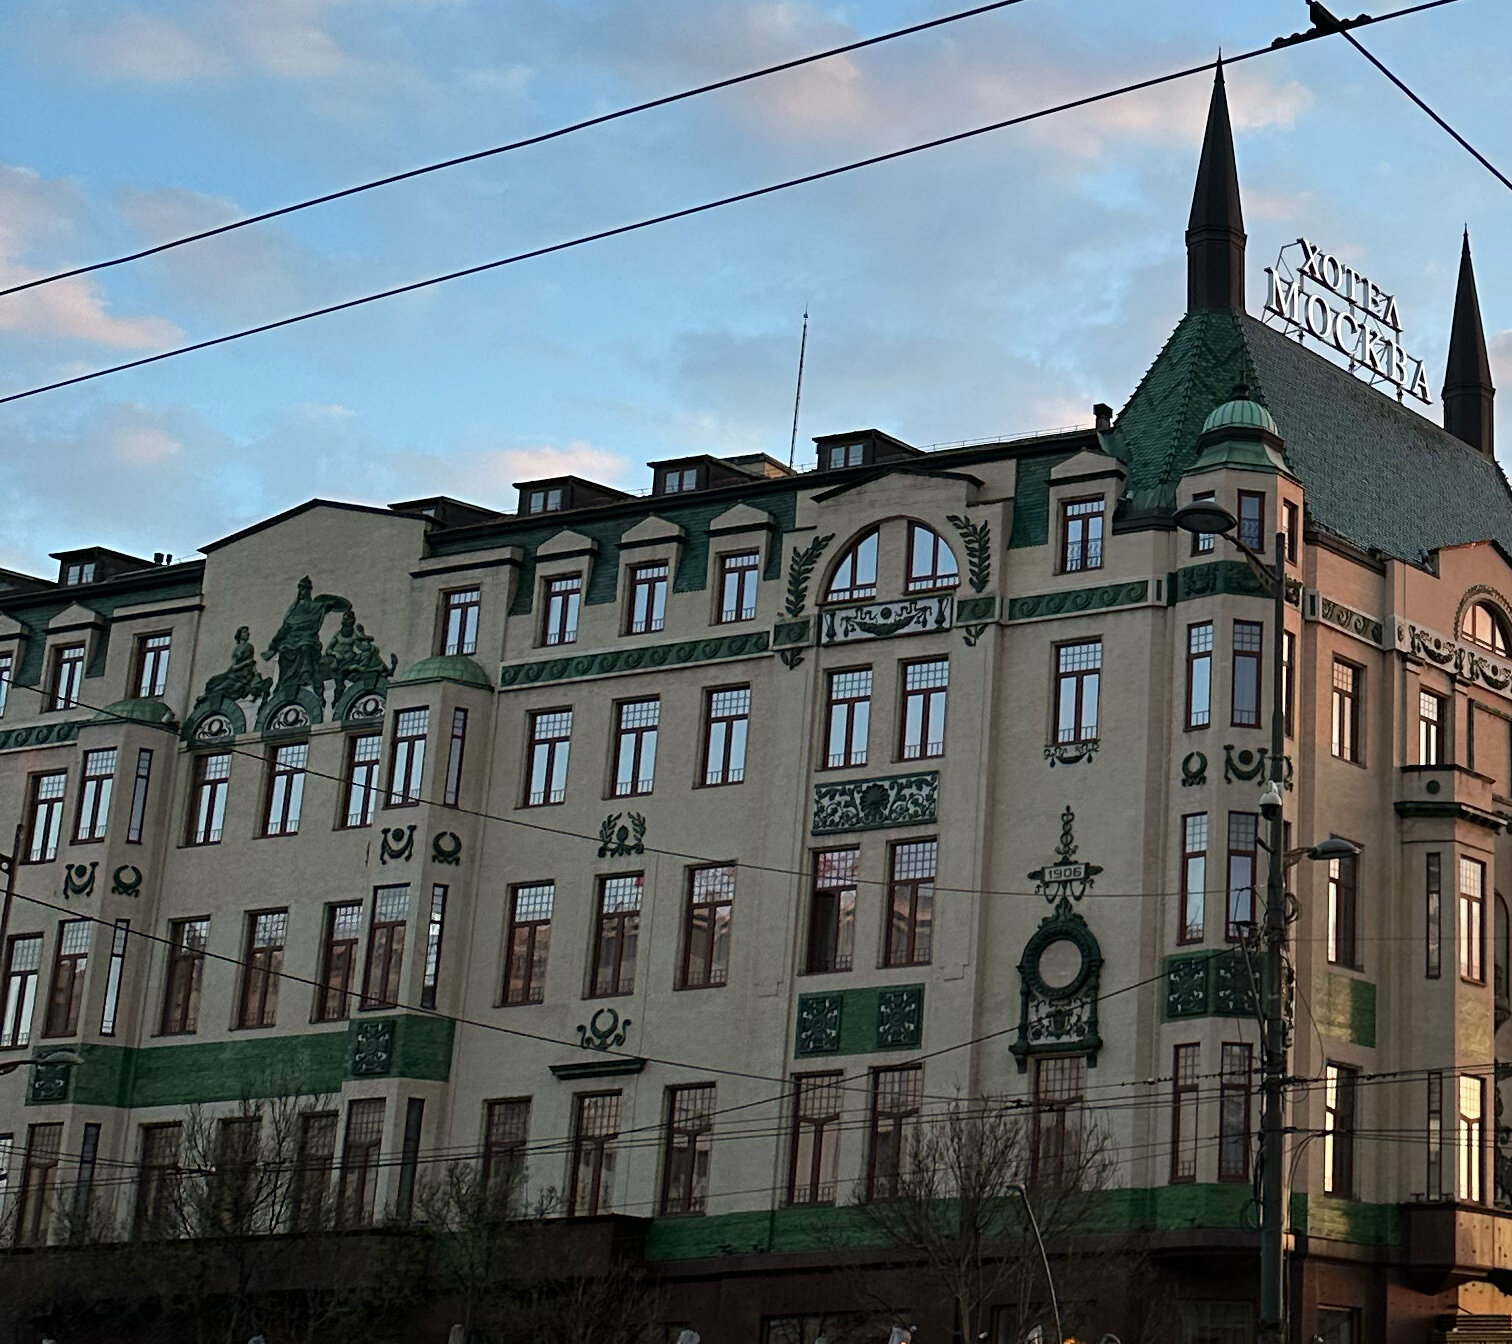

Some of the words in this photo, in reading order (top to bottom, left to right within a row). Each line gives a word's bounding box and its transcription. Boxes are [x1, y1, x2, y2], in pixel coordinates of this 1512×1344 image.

[1298, 238, 1403, 332] ХОТЕЛ
[1264, 267, 1433, 405] МОСКВА
[1048, 867, 1082, 879] 1906
